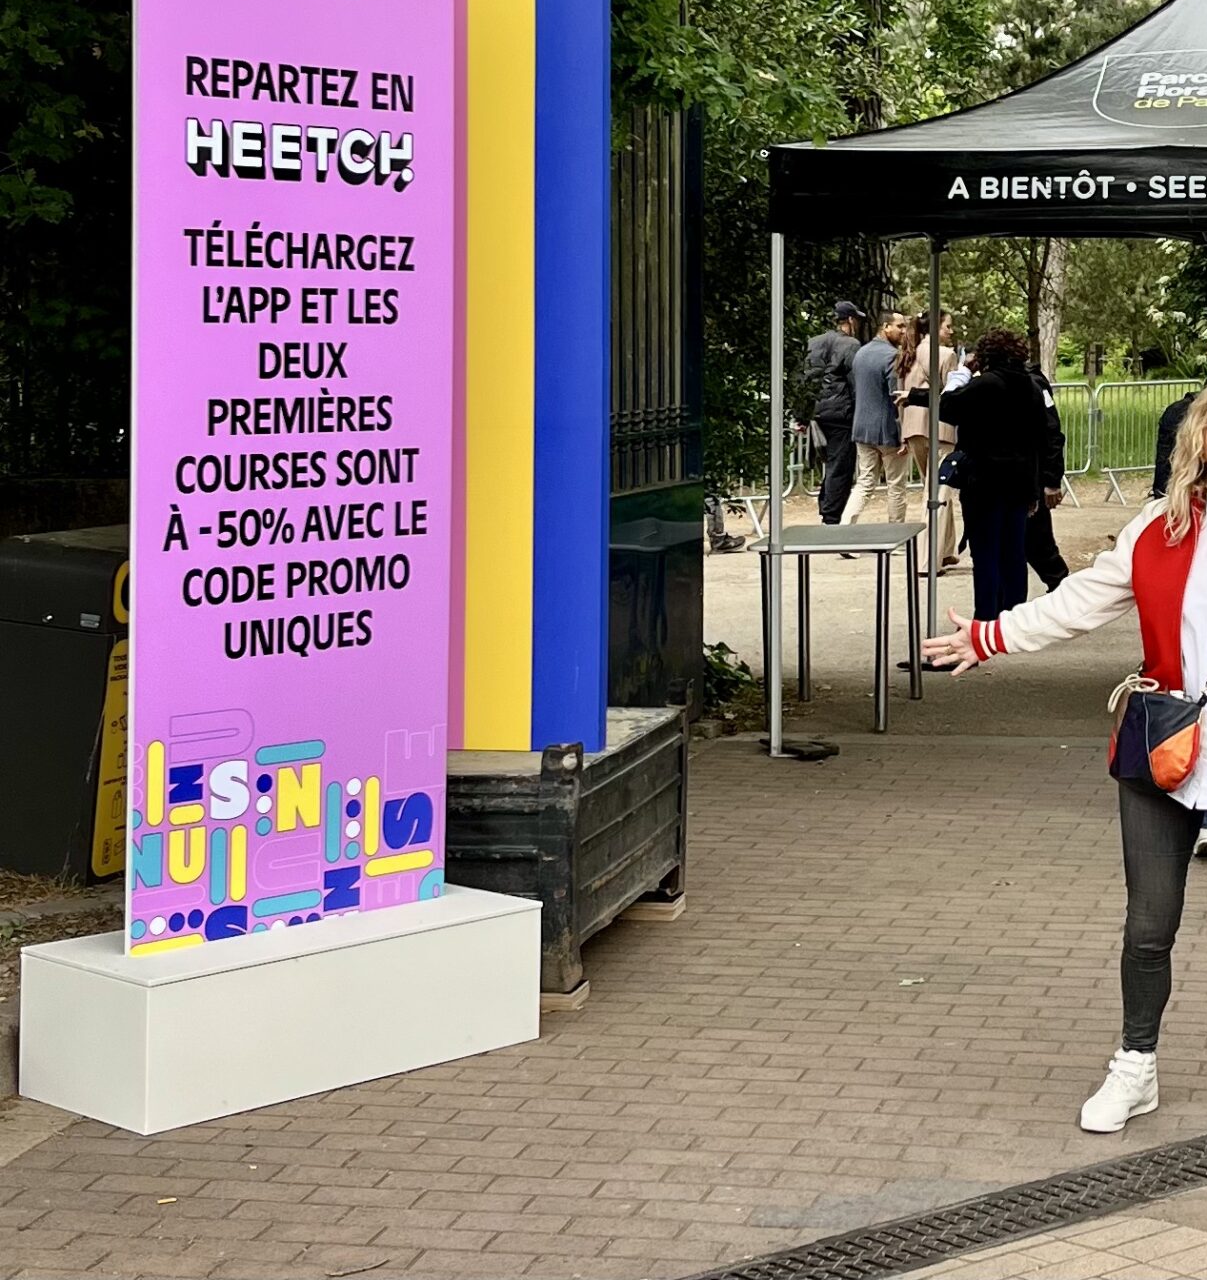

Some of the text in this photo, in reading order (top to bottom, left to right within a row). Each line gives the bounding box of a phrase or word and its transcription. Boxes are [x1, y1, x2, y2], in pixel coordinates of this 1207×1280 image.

[185, 55, 415, 113] REPARTEZ EN
[1133, 97, 1171, 109] de
[948, 176, 970, 200] A
[979, 169, 1115, 201] BIENTÔT
[1148, 175, 1207, 200] SEE
[184, 220, 415, 272] TÉLÉCHARGEZ
[300, 286, 338, 324] ET
[348, 287, 399, 325] LES
[258, 342, 348, 380] DEUX
[207, 387, 394, 437] PREMIÈRES
[175, 447, 421, 494] COURSES SONT
[163, 504, 190, 552] À
[302, 501, 385, 543] AVEC
[395, 500, 428, 536] LE
[182, 553, 411, 607] CODE PROMO
[223, 609, 373, 660] UNIQUES
